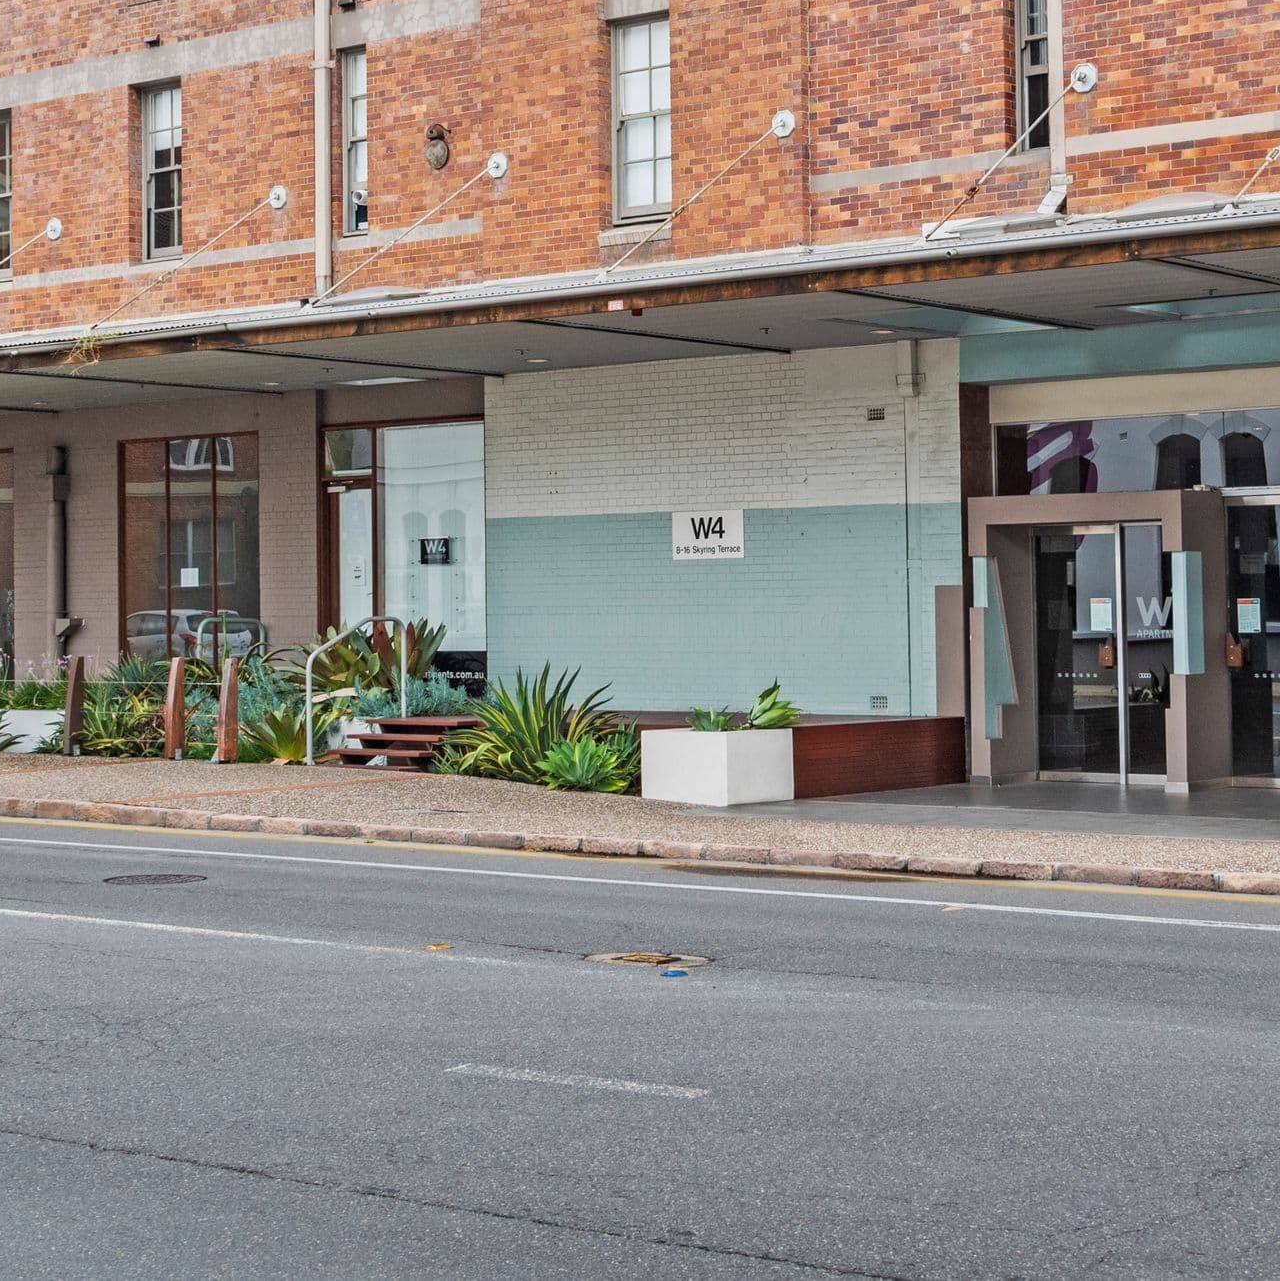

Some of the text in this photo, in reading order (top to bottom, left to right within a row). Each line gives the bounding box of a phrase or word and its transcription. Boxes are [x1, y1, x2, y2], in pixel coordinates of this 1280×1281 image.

[690, 516, 725, 540] W4
[424, 539, 447, 554] W4
[692, 545, 716, 555] Skyring
[717, 544, 741, 553] Terrace
